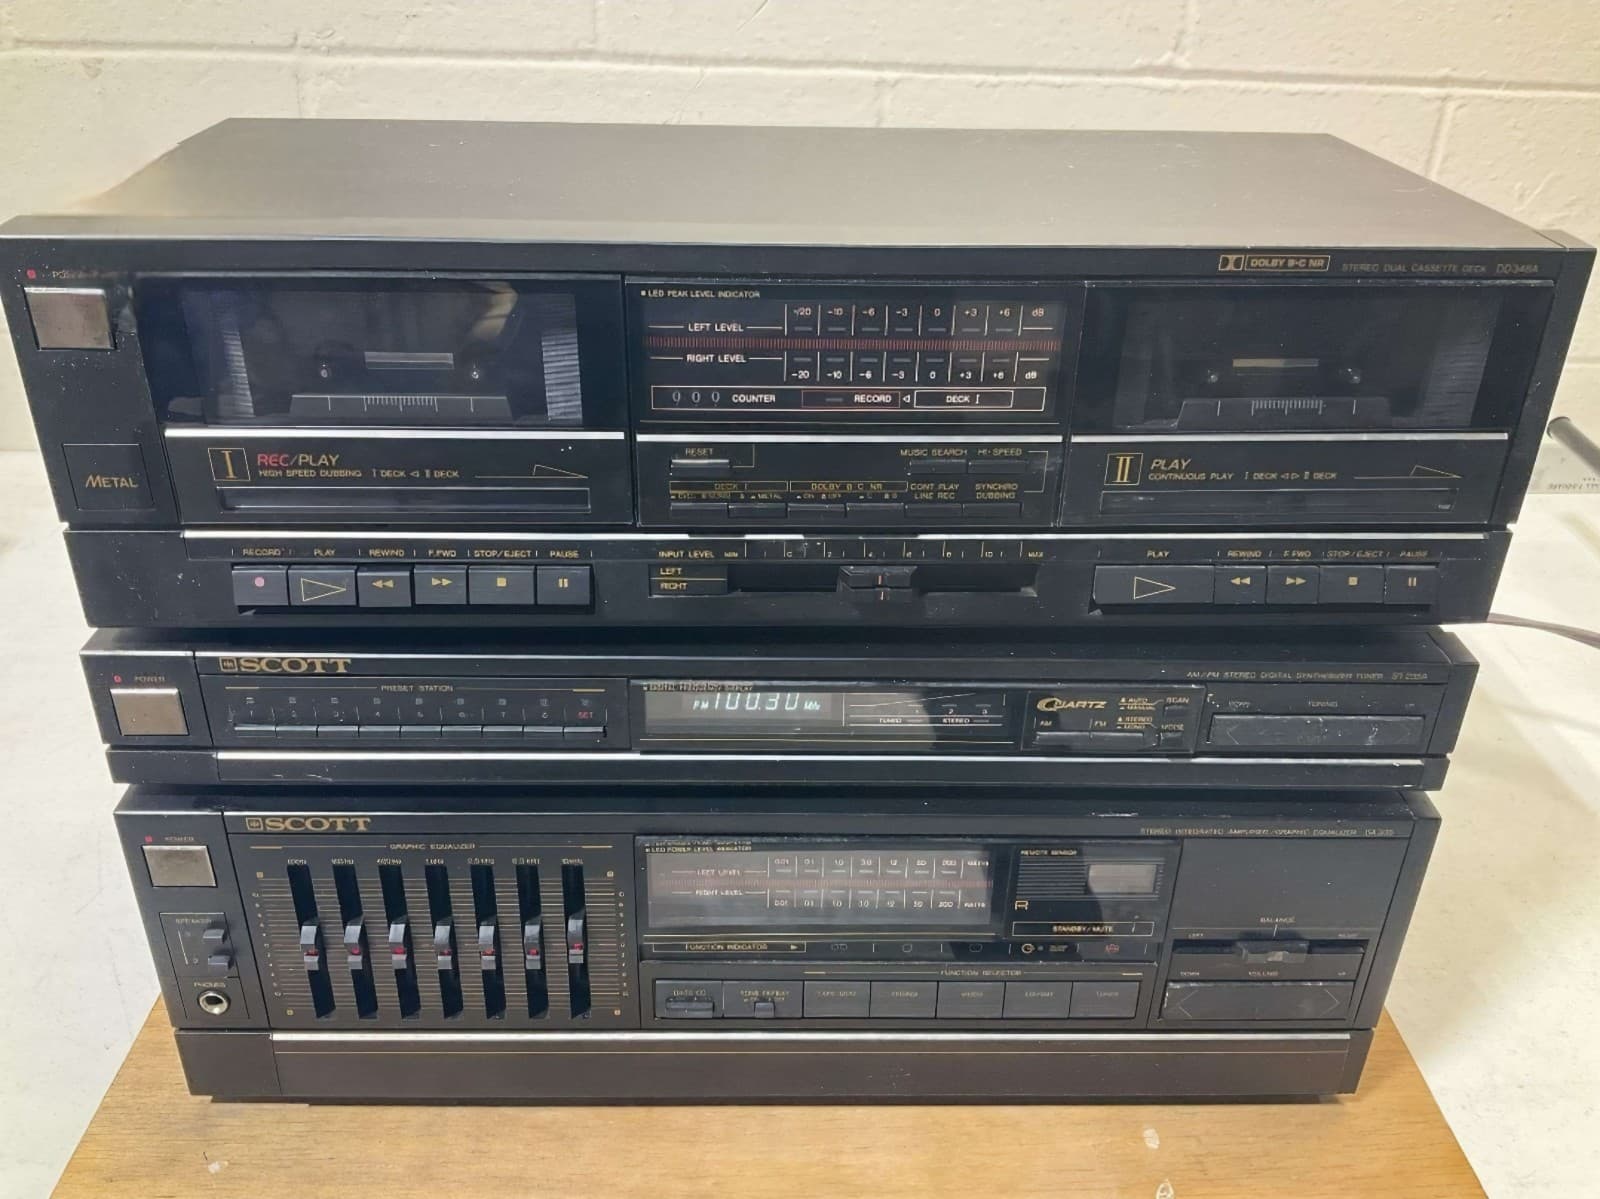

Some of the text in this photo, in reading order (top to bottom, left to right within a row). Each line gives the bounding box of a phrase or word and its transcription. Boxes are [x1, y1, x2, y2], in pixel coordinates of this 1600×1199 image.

[1250, 258, 1284, 267] DOLBY
[1308, 258, 1325, 267] NR
[1383, 263, 1407, 273] DUAL
[667, 290, 688, 298] PEAK
[934, 307, 941, 317] 0
[688, 322, 744, 332] LEFT LEVEL
[686, 353, 747, 364] RIGHT LEVEL
[929, 371, 936, 380] 0
[731, 394, 777, 404] COUNTER
[853, 394, 892, 404] RECORD
[946, 394, 970, 404] DECK
[685, 447, 714, 456] RESET
[900, 448, 968, 457] MUSIC SEARCH
[256, 453, 340, 467] REC/PLAY
[1150, 458, 1192, 470] PLAY
[258, 469, 362, 478] HIGH SPEED DUBBING
[380, 469, 406, 478] DECK
[434, 469, 460, 478] DECK
[1148, 472, 1234, 481] CONTINUOUS PLAY
[1252, 472, 1278, 480] DECK
[1312, 472, 1337, 480] DECK
[85, 475, 139, 489] METAL
[811, 483, 841, 491] DOLBY
[975, 483, 1019, 491] SYNCHRO
[976, 492, 1017, 500] DUBBING
[243, 548, 281, 557] RECORD
[313, 548, 337, 557] PLAY
[368, 548, 406, 558] REWIND
[473, 549, 532, 558] STOP/EJECT
[550, 550, 580, 559] PAUSE
[658, 551, 715, 559] INPUT LEVEL
[1146, 550, 1170, 559] PLAY
[1227, 550, 1263, 559] REWIND
[659, 566, 682, 576] LEFT
[659, 582, 688, 591] RIGHT
[240, 656, 351, 673] SCOTT
[419, 684, 454, 692] STATION
[1036, 697, 1107, 712] QUARTZ
[265, 817, 371, 831] SCOTT
[727, 943, 768, 951] INDICATOR
